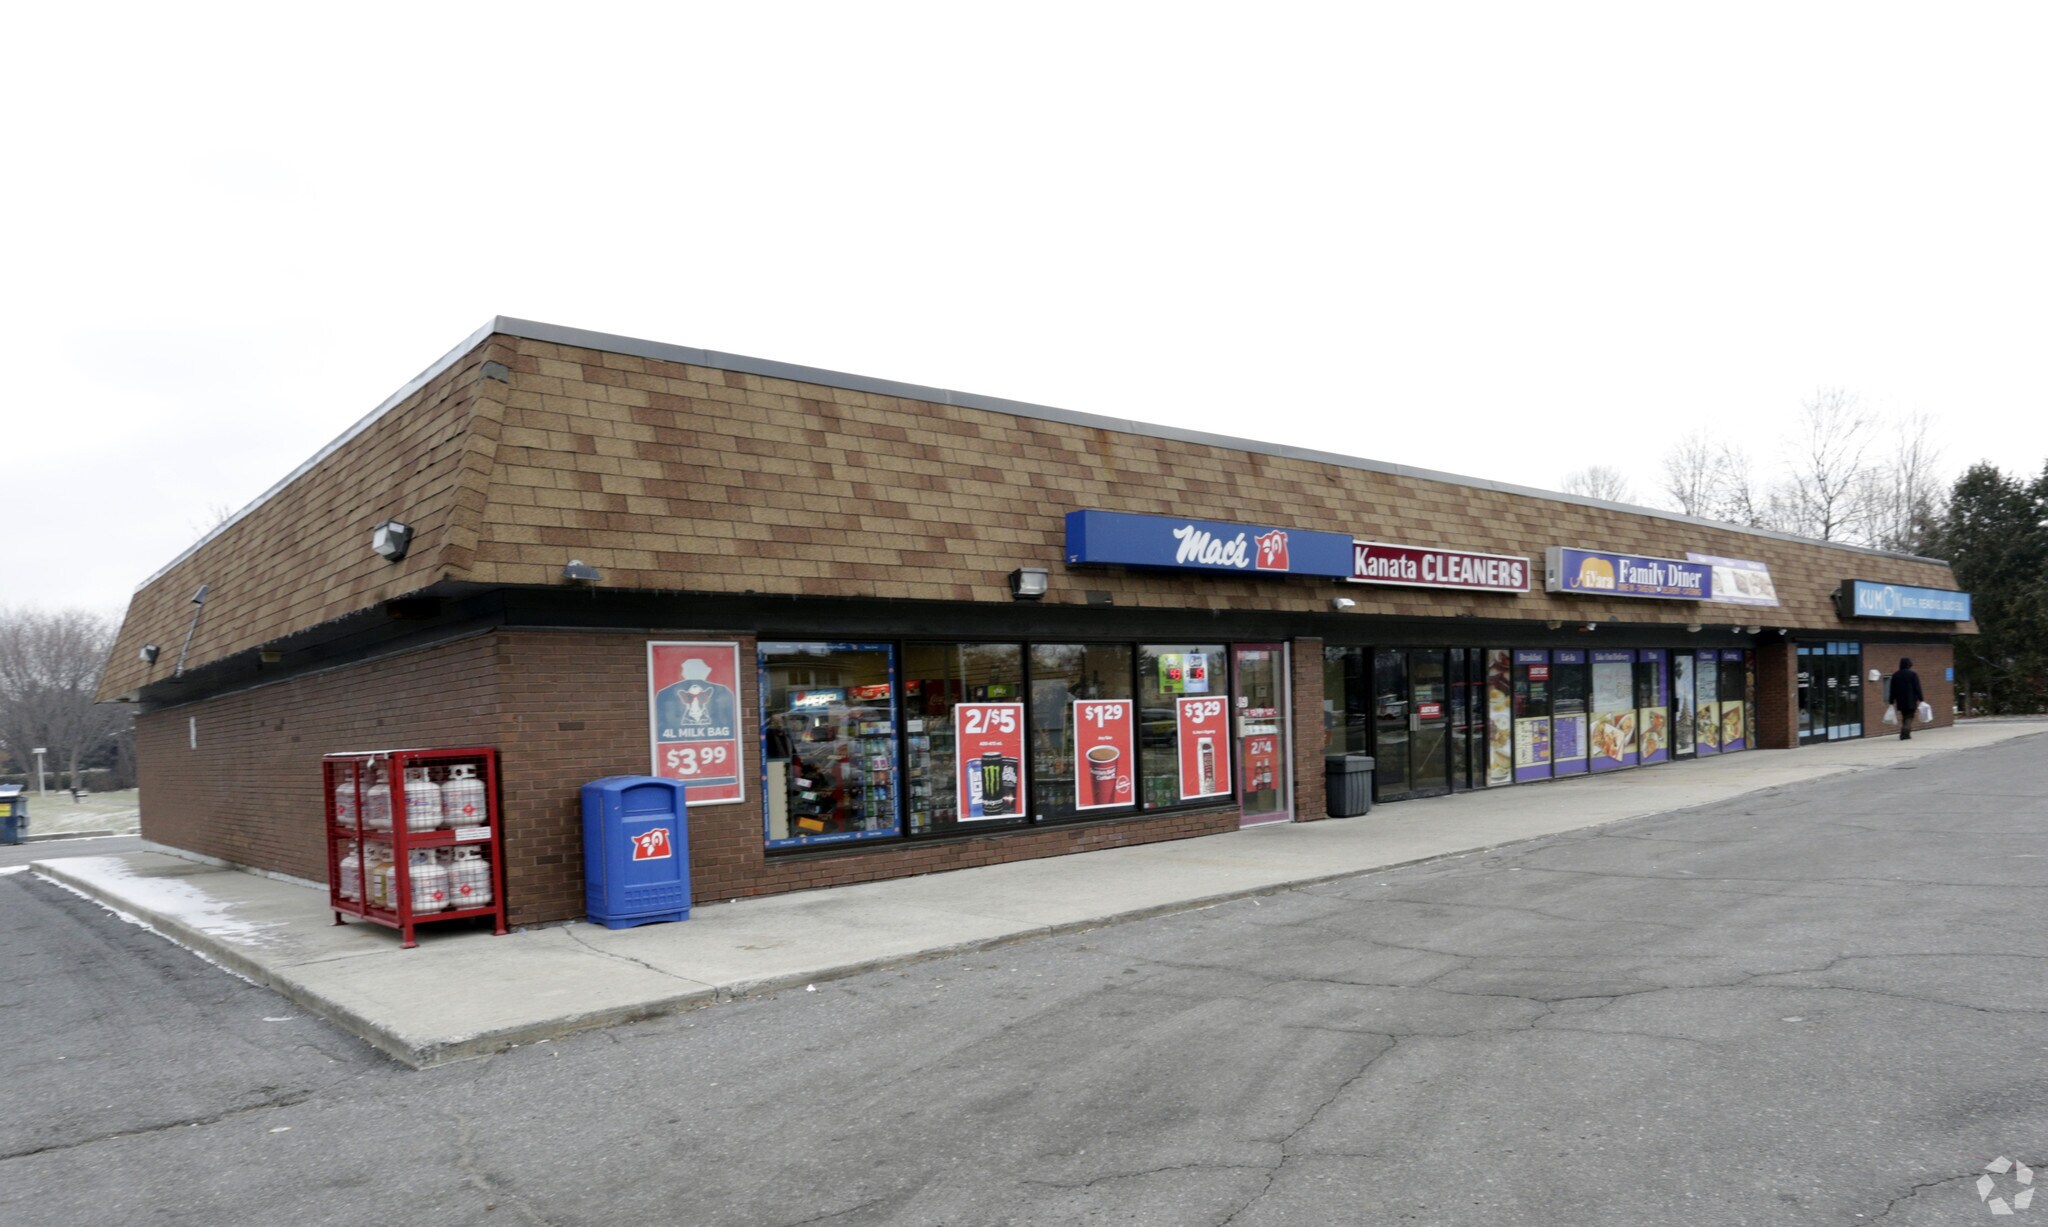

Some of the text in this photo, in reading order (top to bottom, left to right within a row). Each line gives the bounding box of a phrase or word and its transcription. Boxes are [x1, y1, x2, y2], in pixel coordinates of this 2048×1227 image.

[1173, 525, 1249, 568] Mac's
[1354, 546, 1523, 587] Kanata CLEANERS
[1618, 559, 1702, 592] Family Diner
[1859, 586, 1902, 616] KUMON
[663, 726, 730, 738] 4L MILK BAG
[965, 708, 1016, 734] 2/$5
[666, 746, 727, 775] $3.99
